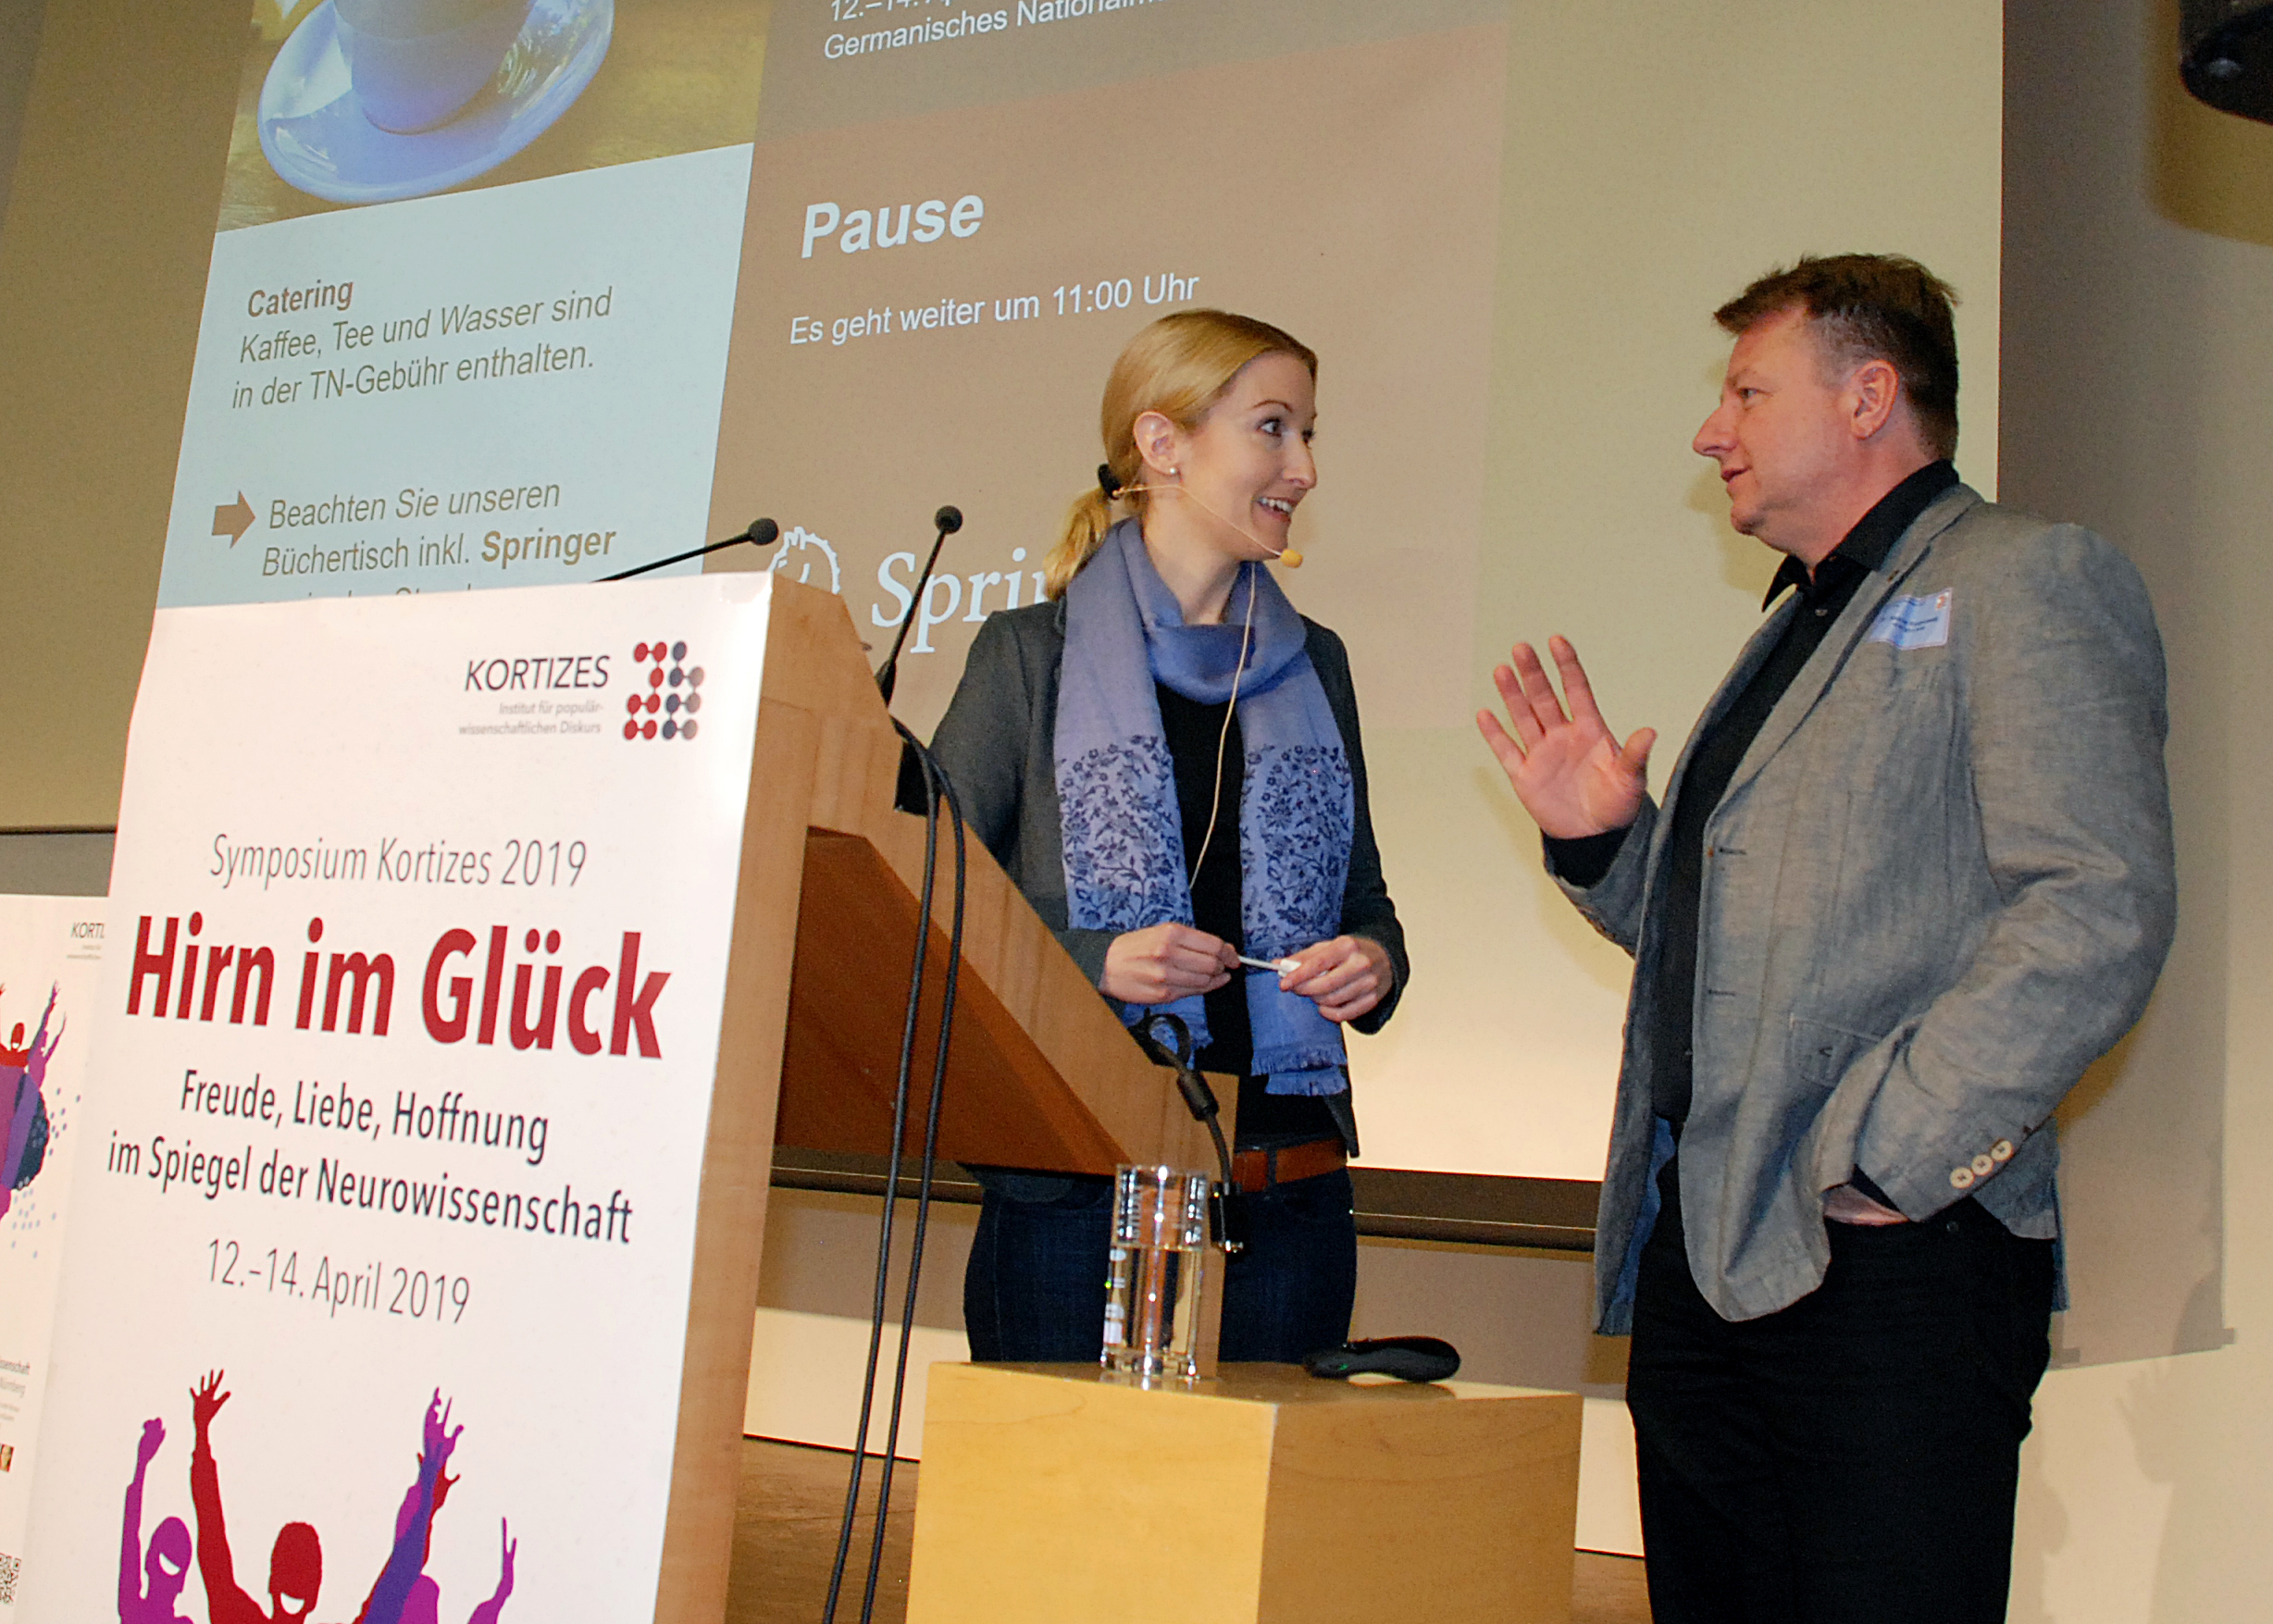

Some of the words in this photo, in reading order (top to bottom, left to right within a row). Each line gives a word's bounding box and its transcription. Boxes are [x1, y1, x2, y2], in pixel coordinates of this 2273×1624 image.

[825, 9, 1008, 59] Germanisches
[801, 195, 983, 258] Pause
[240, 329, 322, 364] Kaffee,
[332, 320, 374, 351] Tee
[382, 308, 432, 344] und
[441, 302, 545, 336] Wasser
[551, 285, 613, 322] sind
[247, 279, 354, 317] Catering
[789, 316, 824, 344] Es
[831, 306, 892, 346] geht
[899, 298, 986, 331] weiter
[994, 295, 1039, 322] um
[1052, 278, 1133, 316] 11:00
[1143, 272, 1200, 304] Uhr
[232, 380, 254, 409] in
[261, 376, 303, 406] der
[310, 355, 450, 401] TN-Gebühr
[456, 342, 593, 381] enthalten.
[269, 494, 386, 529] Beachten
[395, 487, 440, 519] Sie
[448, 484, 560, 515] unseren
[262, 538, 409, 576] Büchertisch
[418, 532, 469, 567] inkl.
[480, 527, 617, 570] Springer
[465, 654, 611, 691] KORTIZES
[459, 720, 556, 736] wissenschaftlichen
[559, 719, 602, 735] Diskurs
[499, 701, 537, 715] Institut
[539, 700, 553, 714] für
[210, 834, 367, 891] Symposium
[377, 837, 492, 886] Kortizes
[501, 838, 587, 887] 2019
[126, 911, 275, 1027] Hirn
[294, 917, 395, 1037] im
[422, 925, 672, 1060] Glück
[181, 1069, 282, 1129] Freude,
[293, 1080, 380, 1141] Liebe,
[392, 1090, 549, 1167] Hoffnung
[107, 1130, 141, 1175] im
[147, 1135, 252, 1200] Spiegel
[259, 1148, 309, 1198] der
[316, 1158, 633, 1245] Neurowissenschaft
[311, 1256, 382, 1319] April
[389, 1267, 470, 1324] 2019
